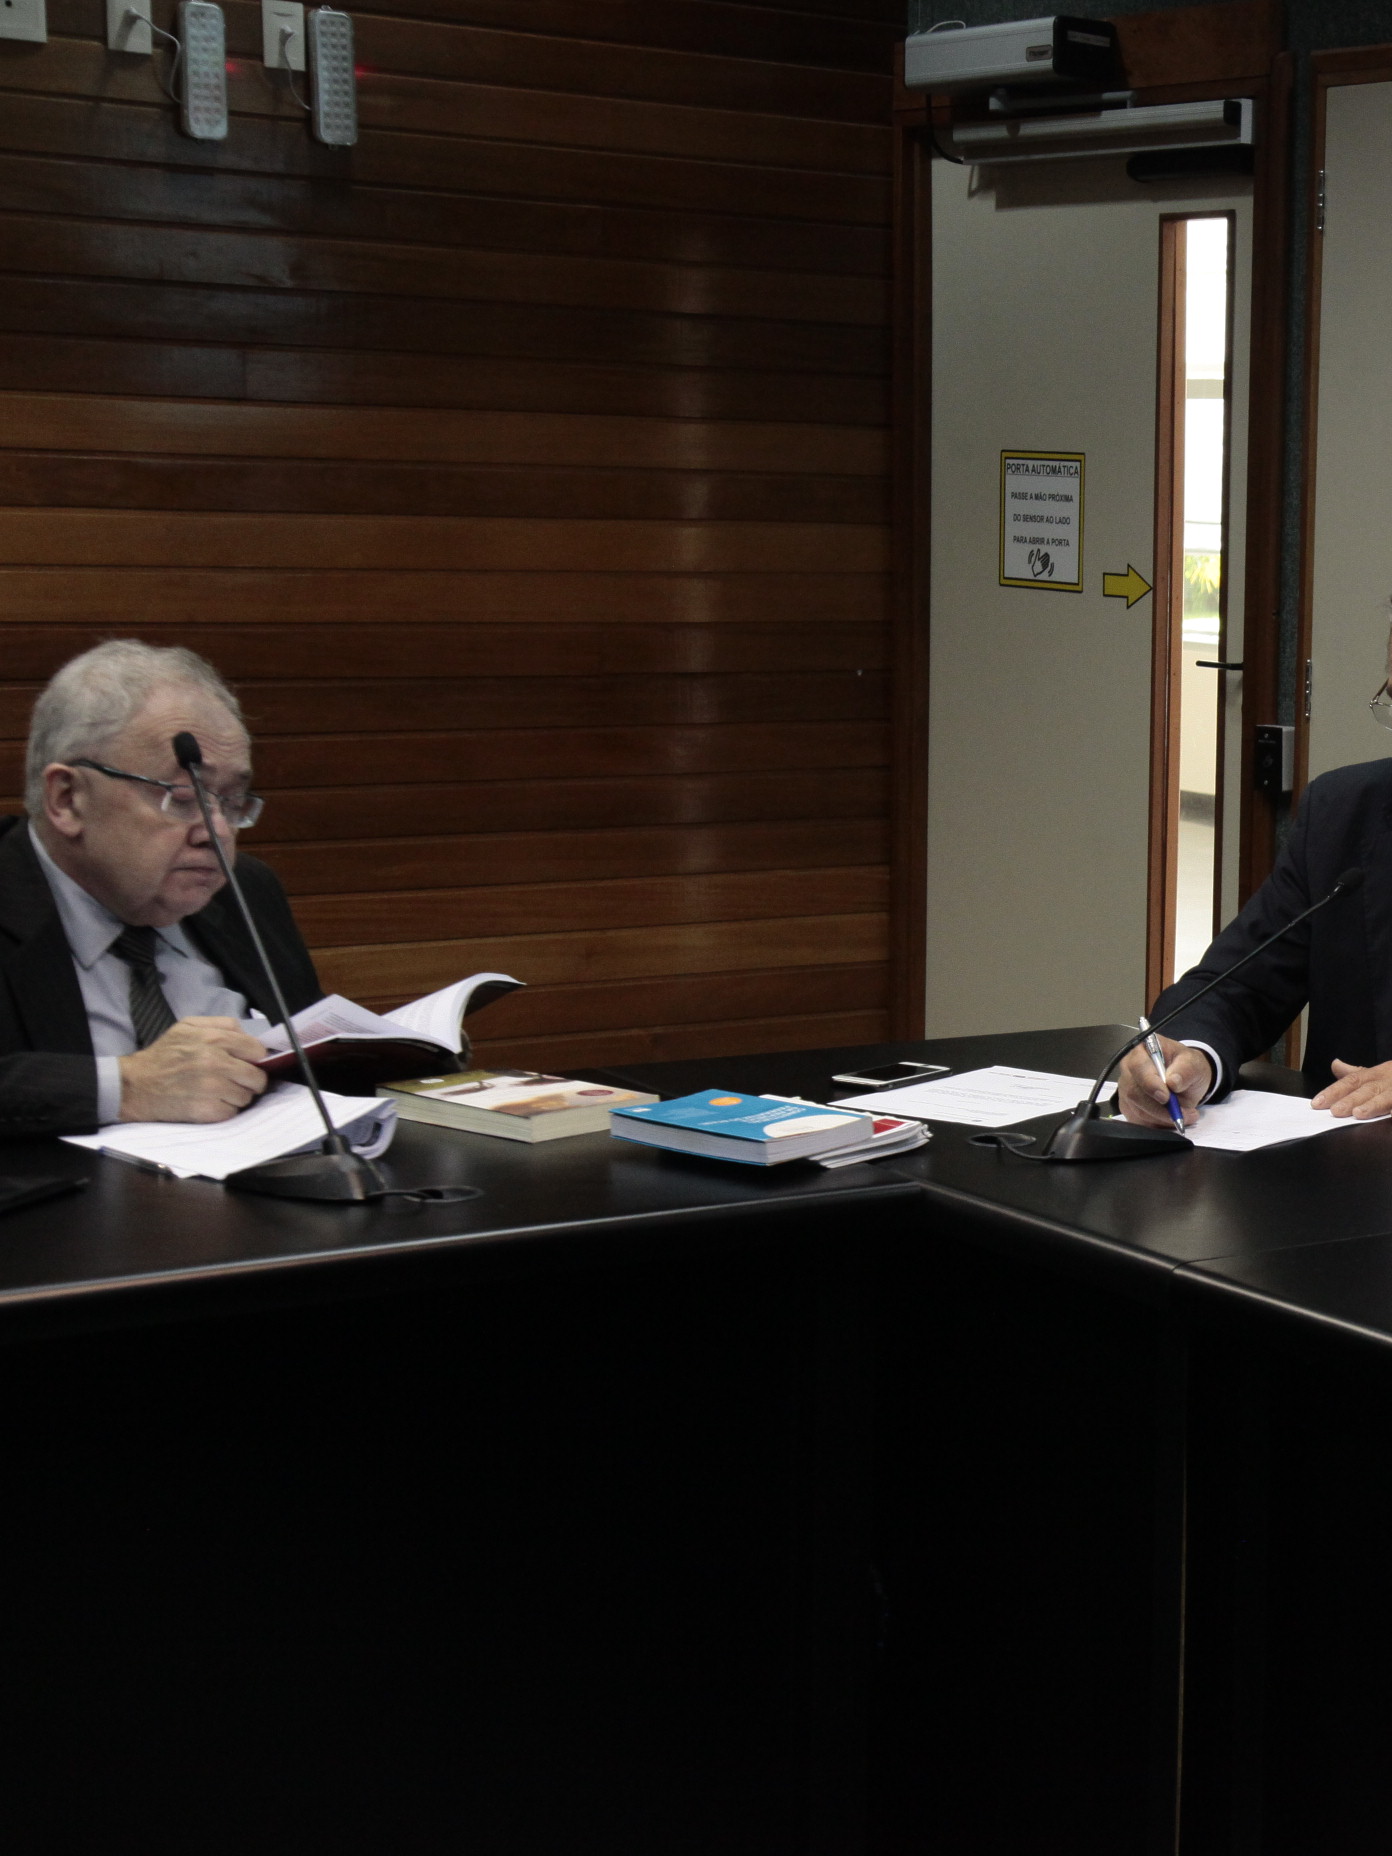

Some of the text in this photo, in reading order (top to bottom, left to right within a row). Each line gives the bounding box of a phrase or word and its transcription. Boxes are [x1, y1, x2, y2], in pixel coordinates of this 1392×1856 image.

[1006, 462, 1030, 474] PORTA
[1011, 492, 1028, 500] PASSE
[1013, 513, 1071, 525] DO SENSOR AO LADO
[1013, 535, 1027, 544] PARA
[1029, 536, 1045, 545] ABRIR
[1051, 538, 1070, 547] PORTA
